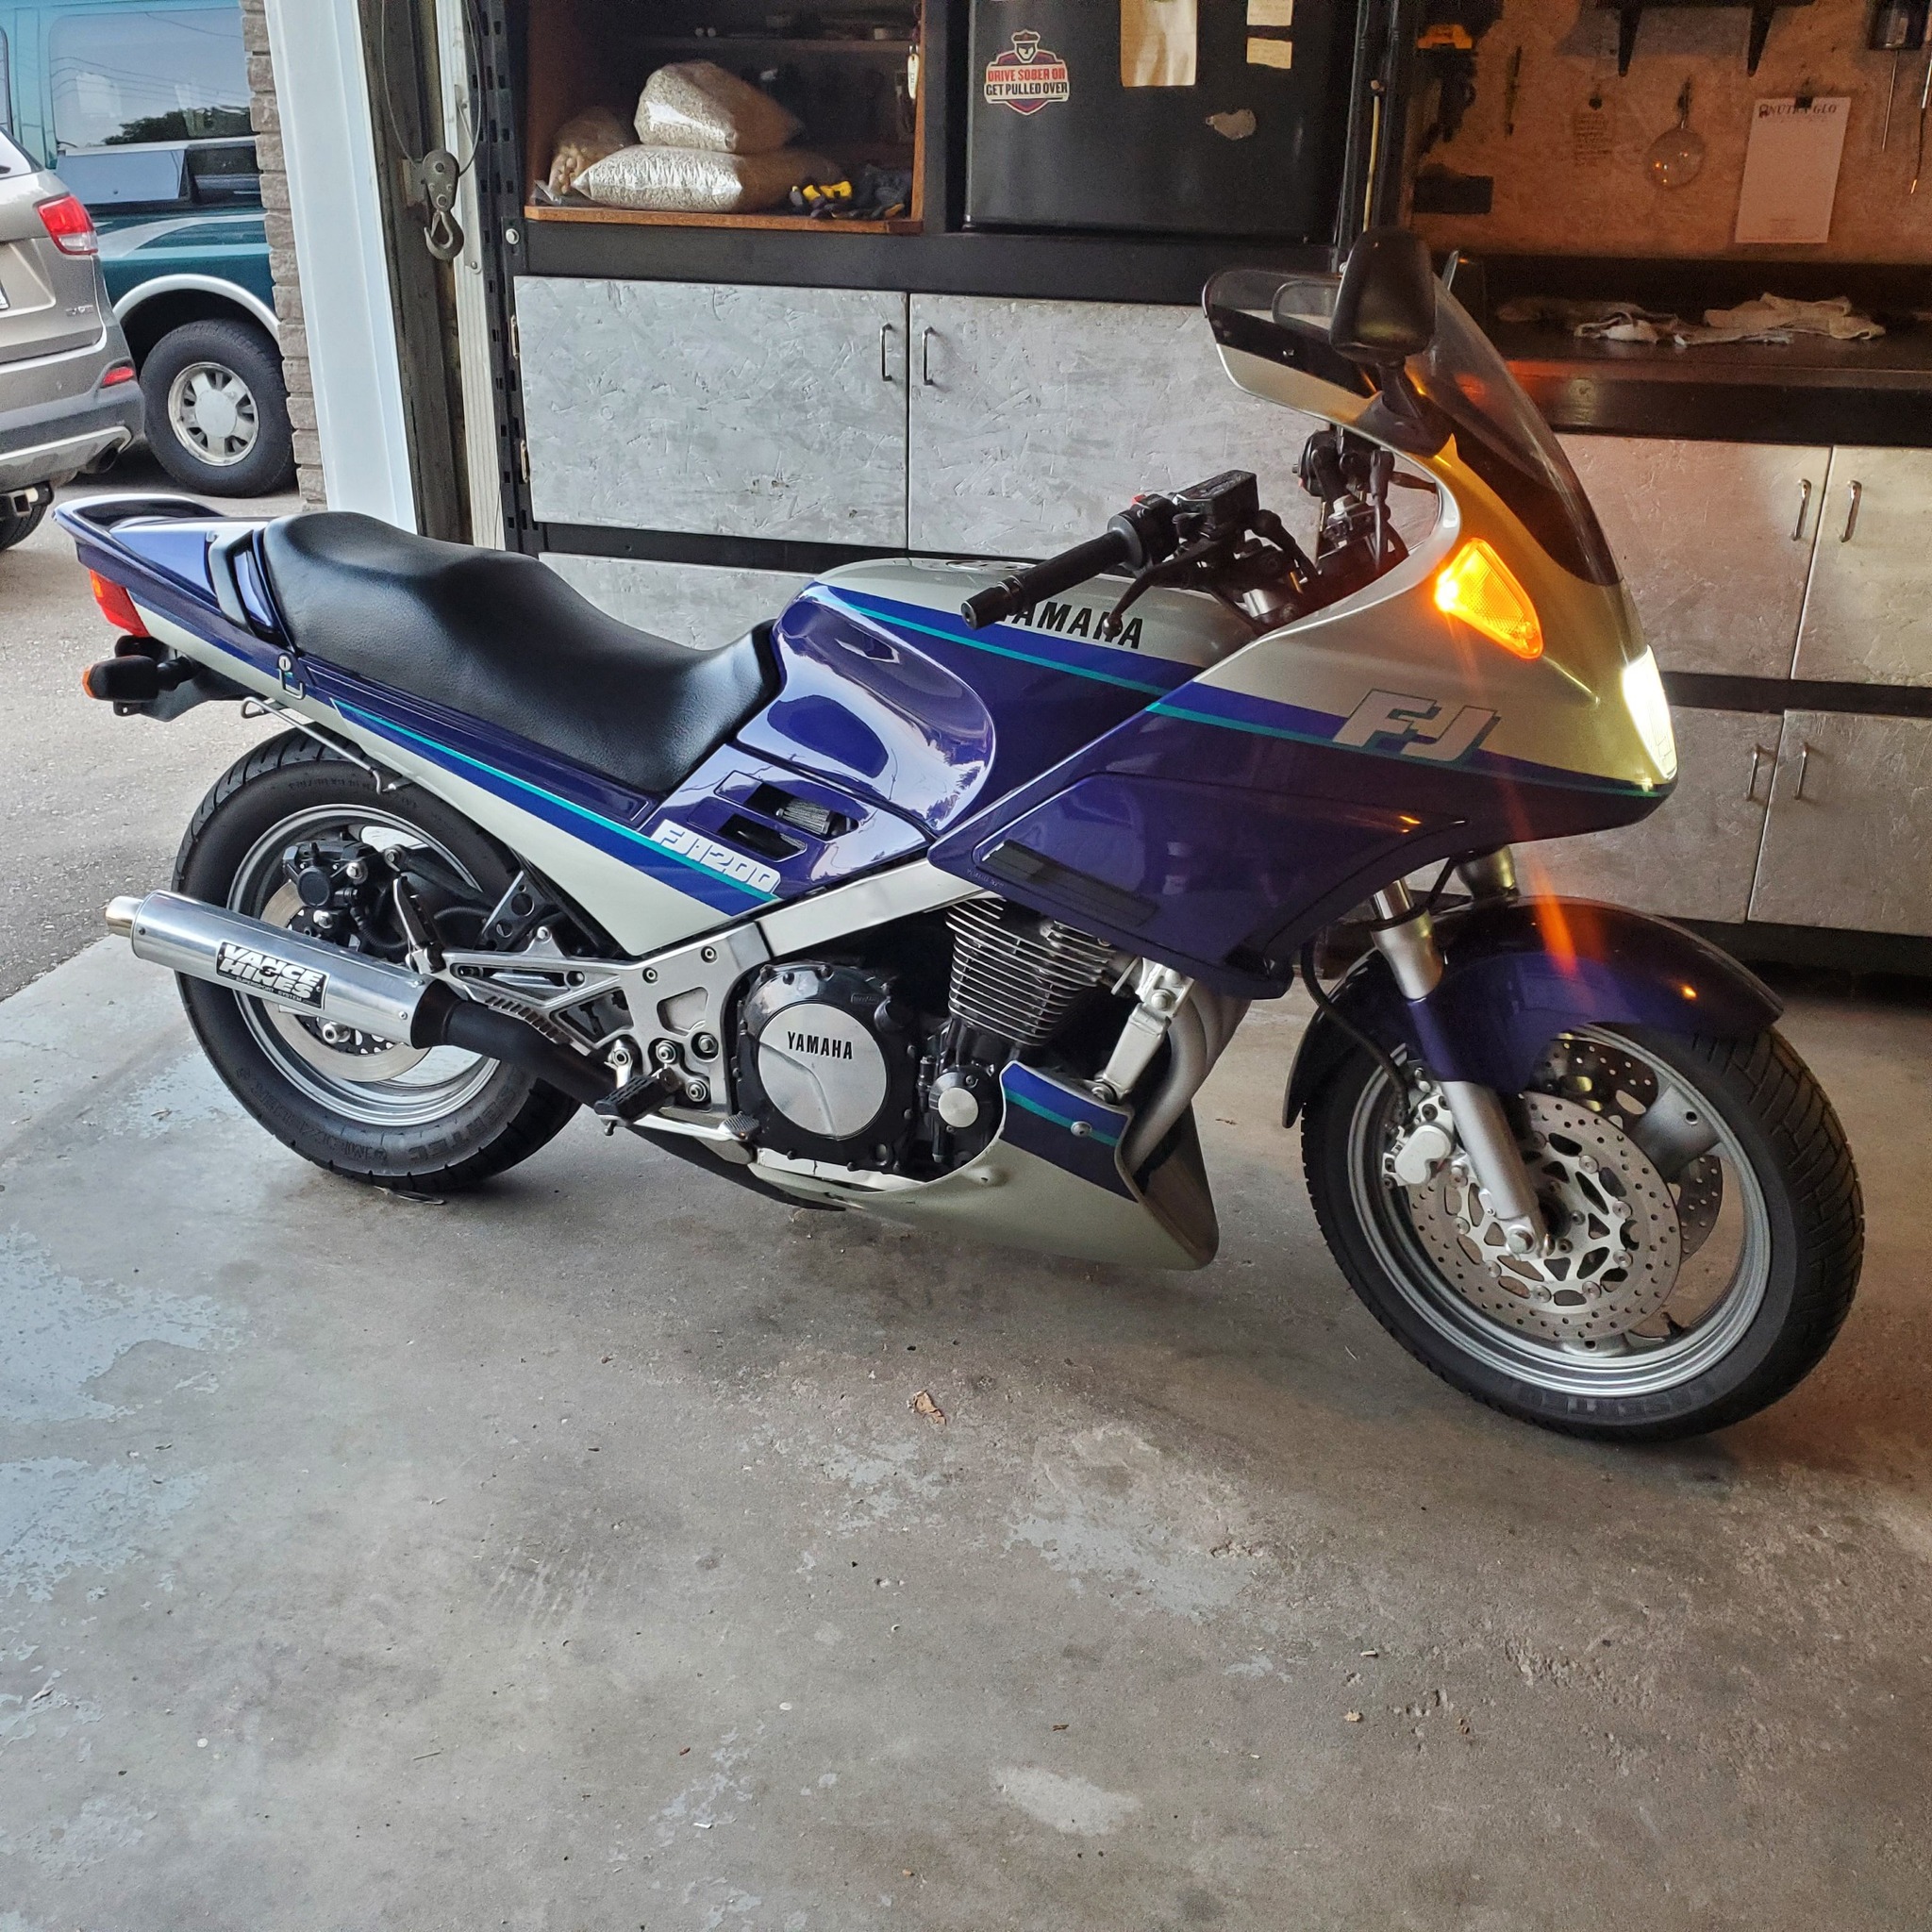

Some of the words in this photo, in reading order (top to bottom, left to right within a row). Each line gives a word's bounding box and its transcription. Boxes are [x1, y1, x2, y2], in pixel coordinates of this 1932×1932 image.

[986, 84, 1004, 96] GET
[1006, 82, 1041, 95] PULLED
[1042, 81, 1067, 94] OVER
[988, 70, 1016, 82] DRIVE
[1018, 68, 1049, 81] SOBER
[1052, 67, 1065, 79] OR
[1000, 601, 1142, 649] AMAHA
[1332, 689, 1500, 762] FJ
[219, 958, 313, 999] HINES
[225, 944, 323, 987] VANCE
[788, 1031, 853, 1060] YAMAHA
